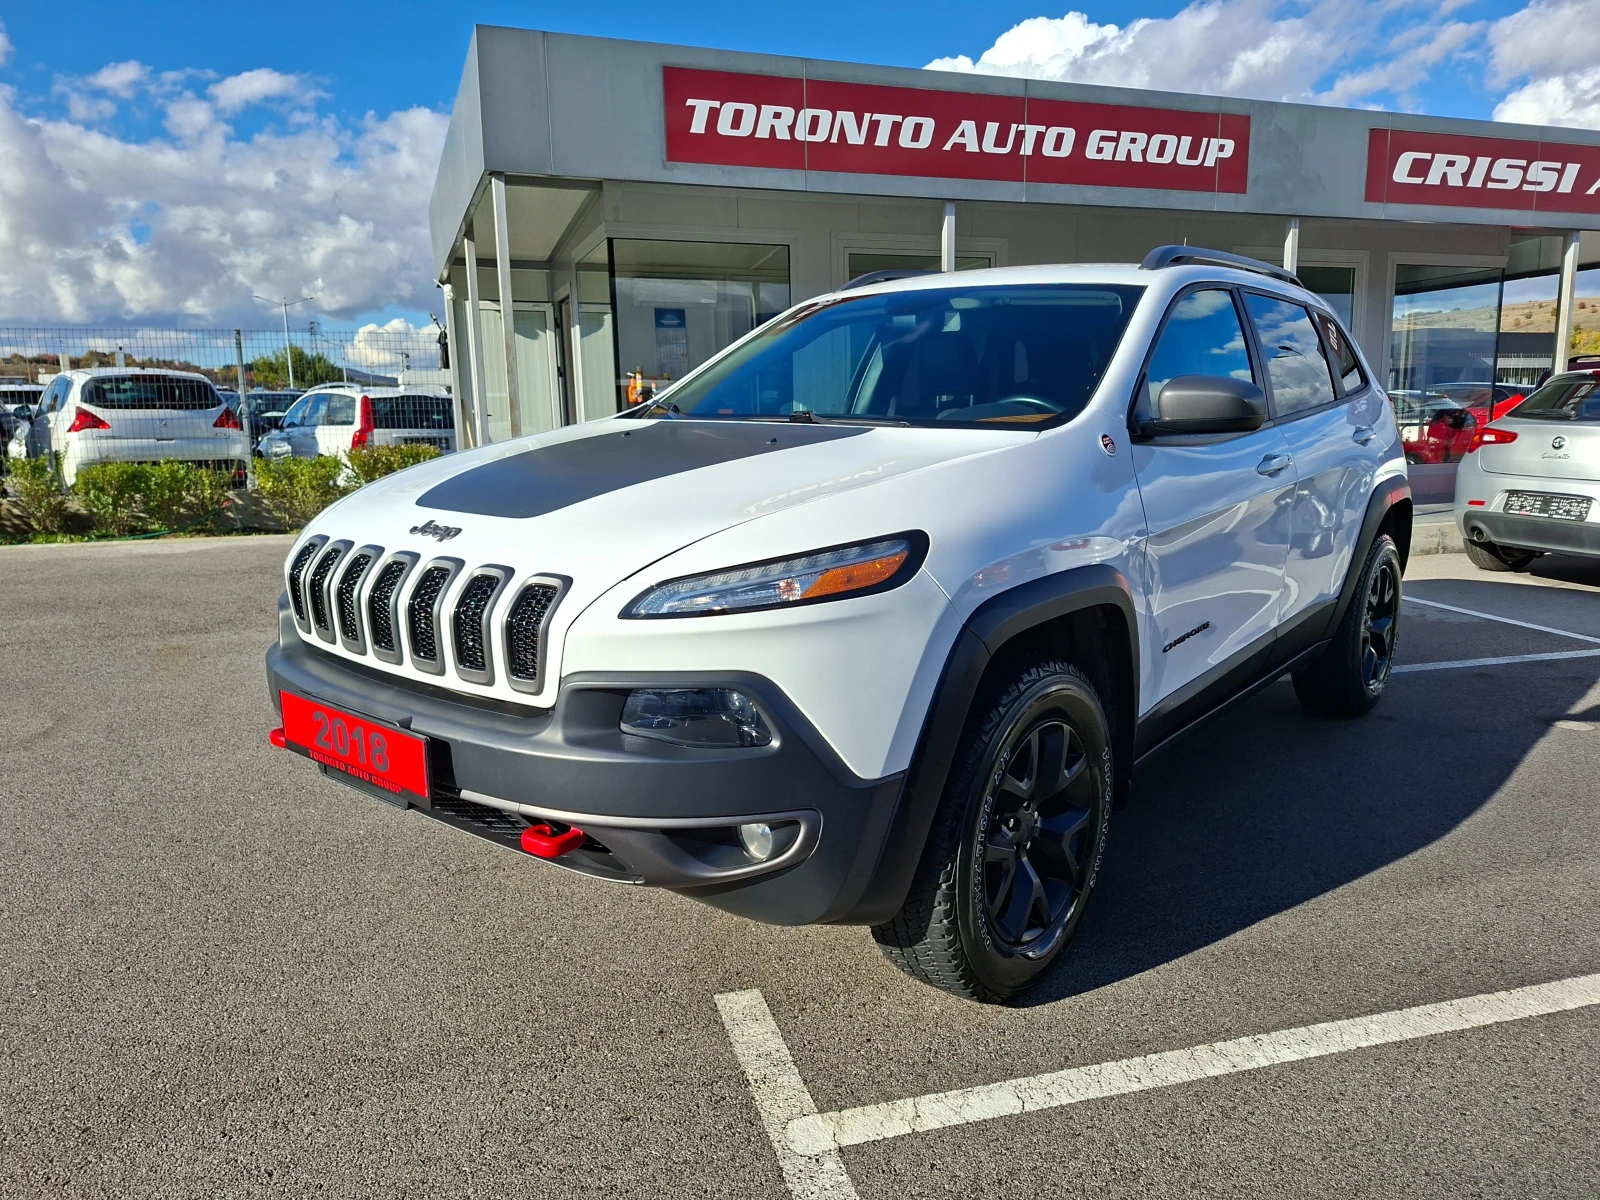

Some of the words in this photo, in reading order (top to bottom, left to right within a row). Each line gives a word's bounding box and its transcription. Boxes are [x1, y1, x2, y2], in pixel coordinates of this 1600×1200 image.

[685, 98, 935, 149] TORONTO
[942, 119, 1076, 158] AUTO
[1084, 129, 1236, 168] GROUP
[1392, 151, 1582, 194] CRISSI
[409, 519, 463, 542] Jeep
[312, 710, 390, 773] 2018
[308, 749, 346, 772] TORONTO
[347, 765, 370, 782] AUTO
[371, 775, 403, 794] GROUP
